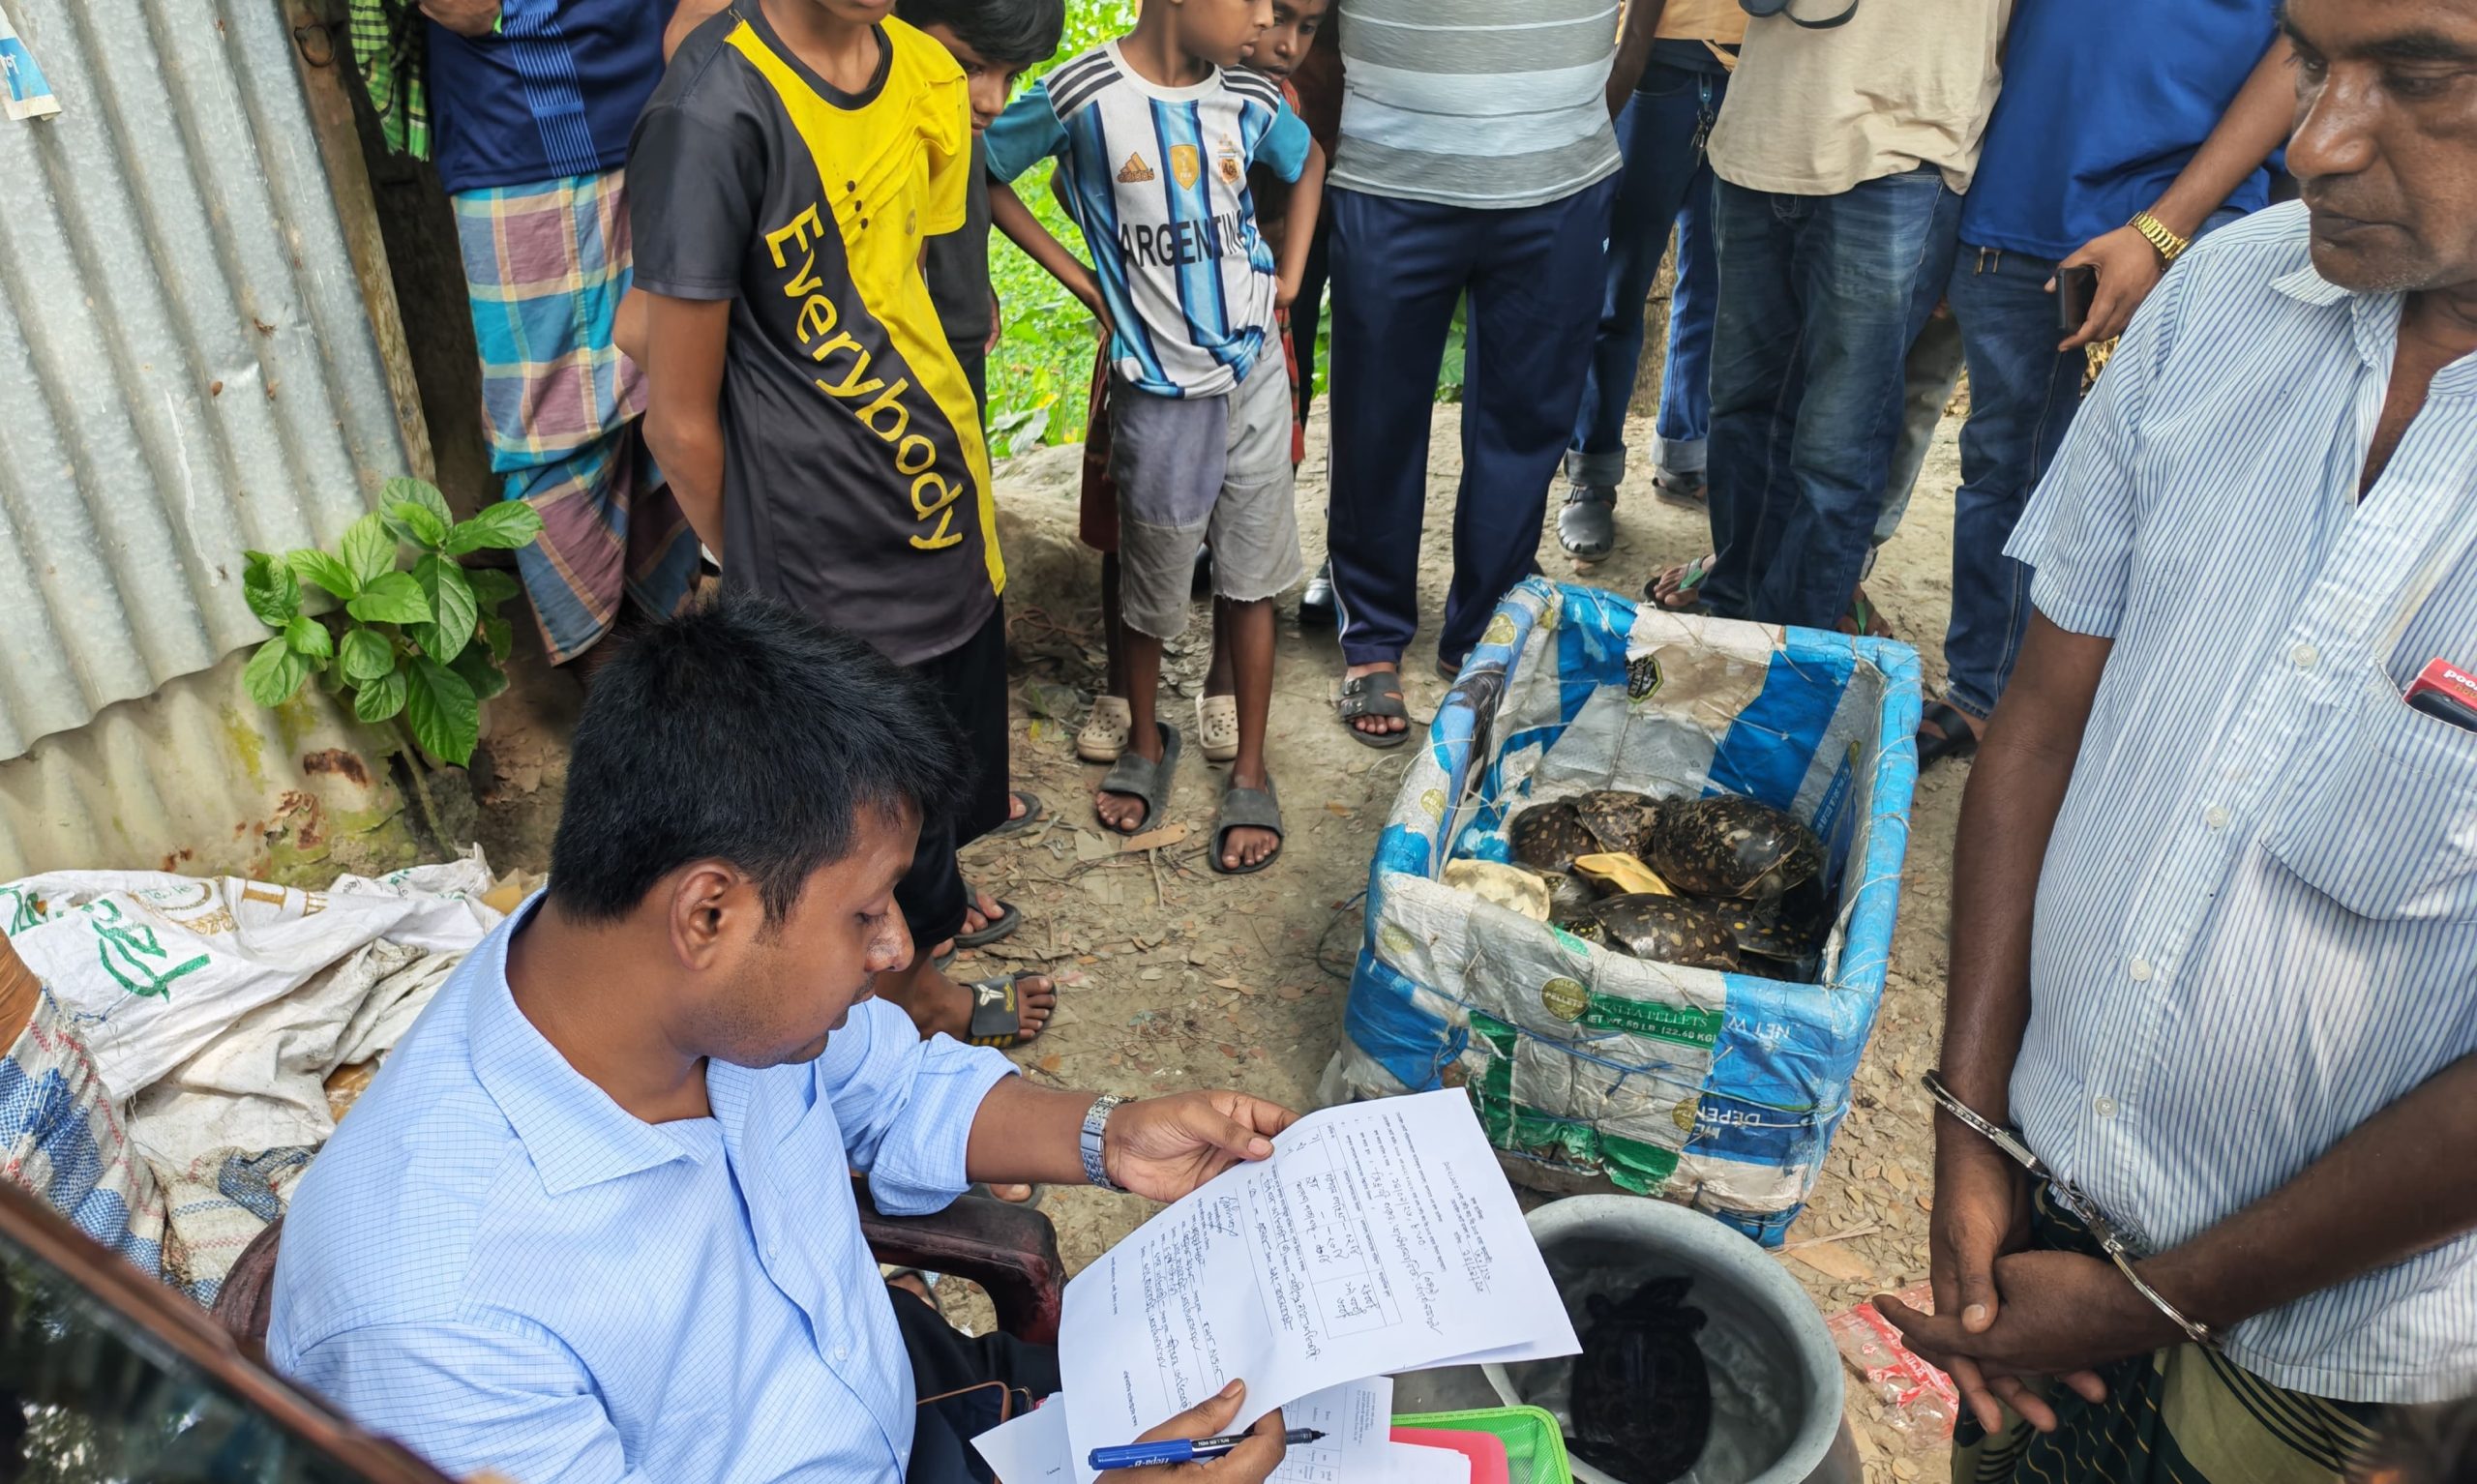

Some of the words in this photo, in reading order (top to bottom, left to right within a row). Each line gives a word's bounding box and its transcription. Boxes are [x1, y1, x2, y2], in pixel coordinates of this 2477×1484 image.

[1117, 168, 1155, 184] adidas
[765, 201, 964, 550] Everybody
[1647, 1010, 1709, 1027] PELLETS
[1754, 1021, 1791, 1039] NET
